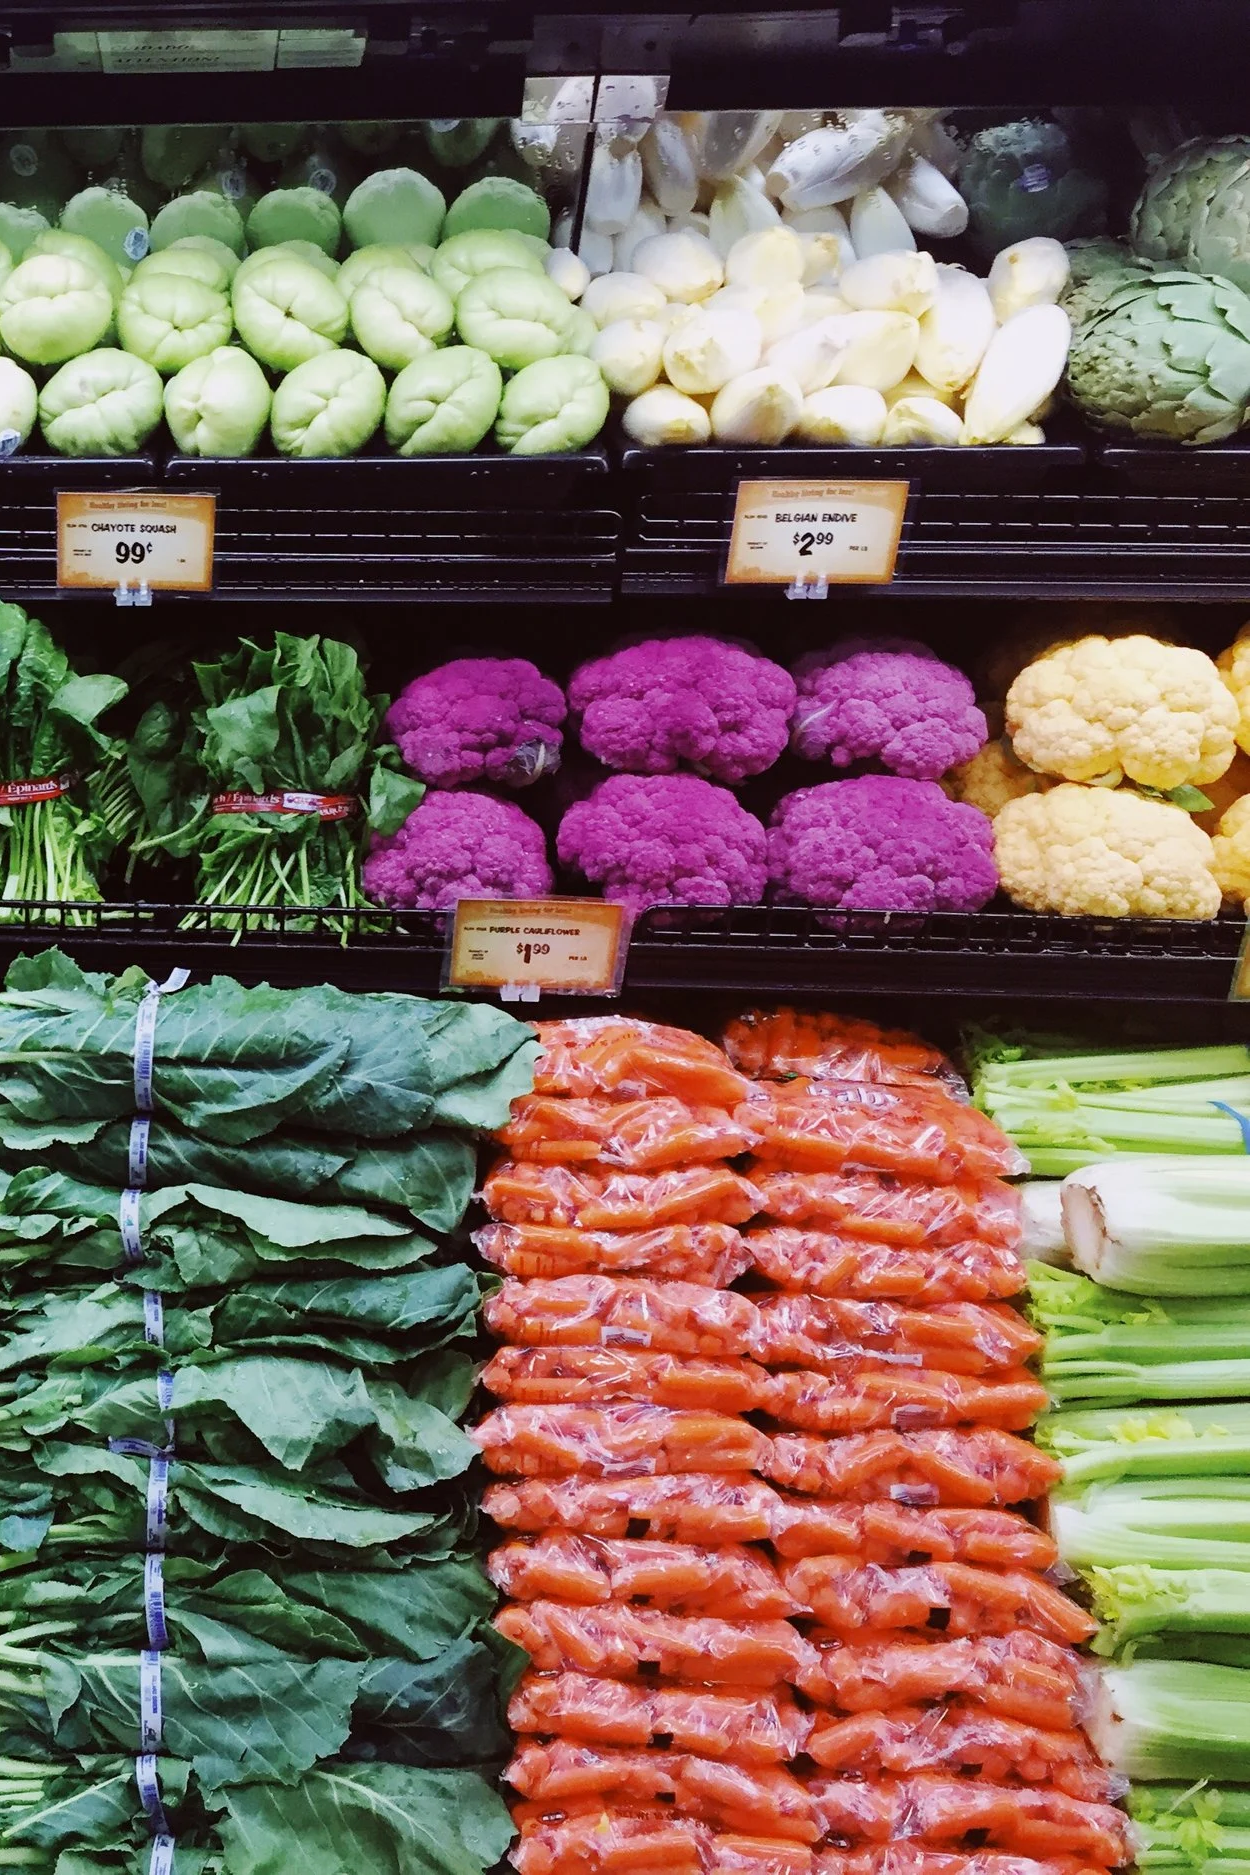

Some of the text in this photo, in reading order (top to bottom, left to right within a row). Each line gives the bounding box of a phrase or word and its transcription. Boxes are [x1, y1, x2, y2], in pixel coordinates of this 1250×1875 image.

[775, 513, 818, 522] BELGIAN
[822, 513, 857, 522] ENDIVE
[92, 523, 135, 533] CHAYOTE
[140, 524, 177, 534] SQUASH
[115, 541, 154, 564] 99¢
[524, 928, 580, 936] CAULIFLOWER
